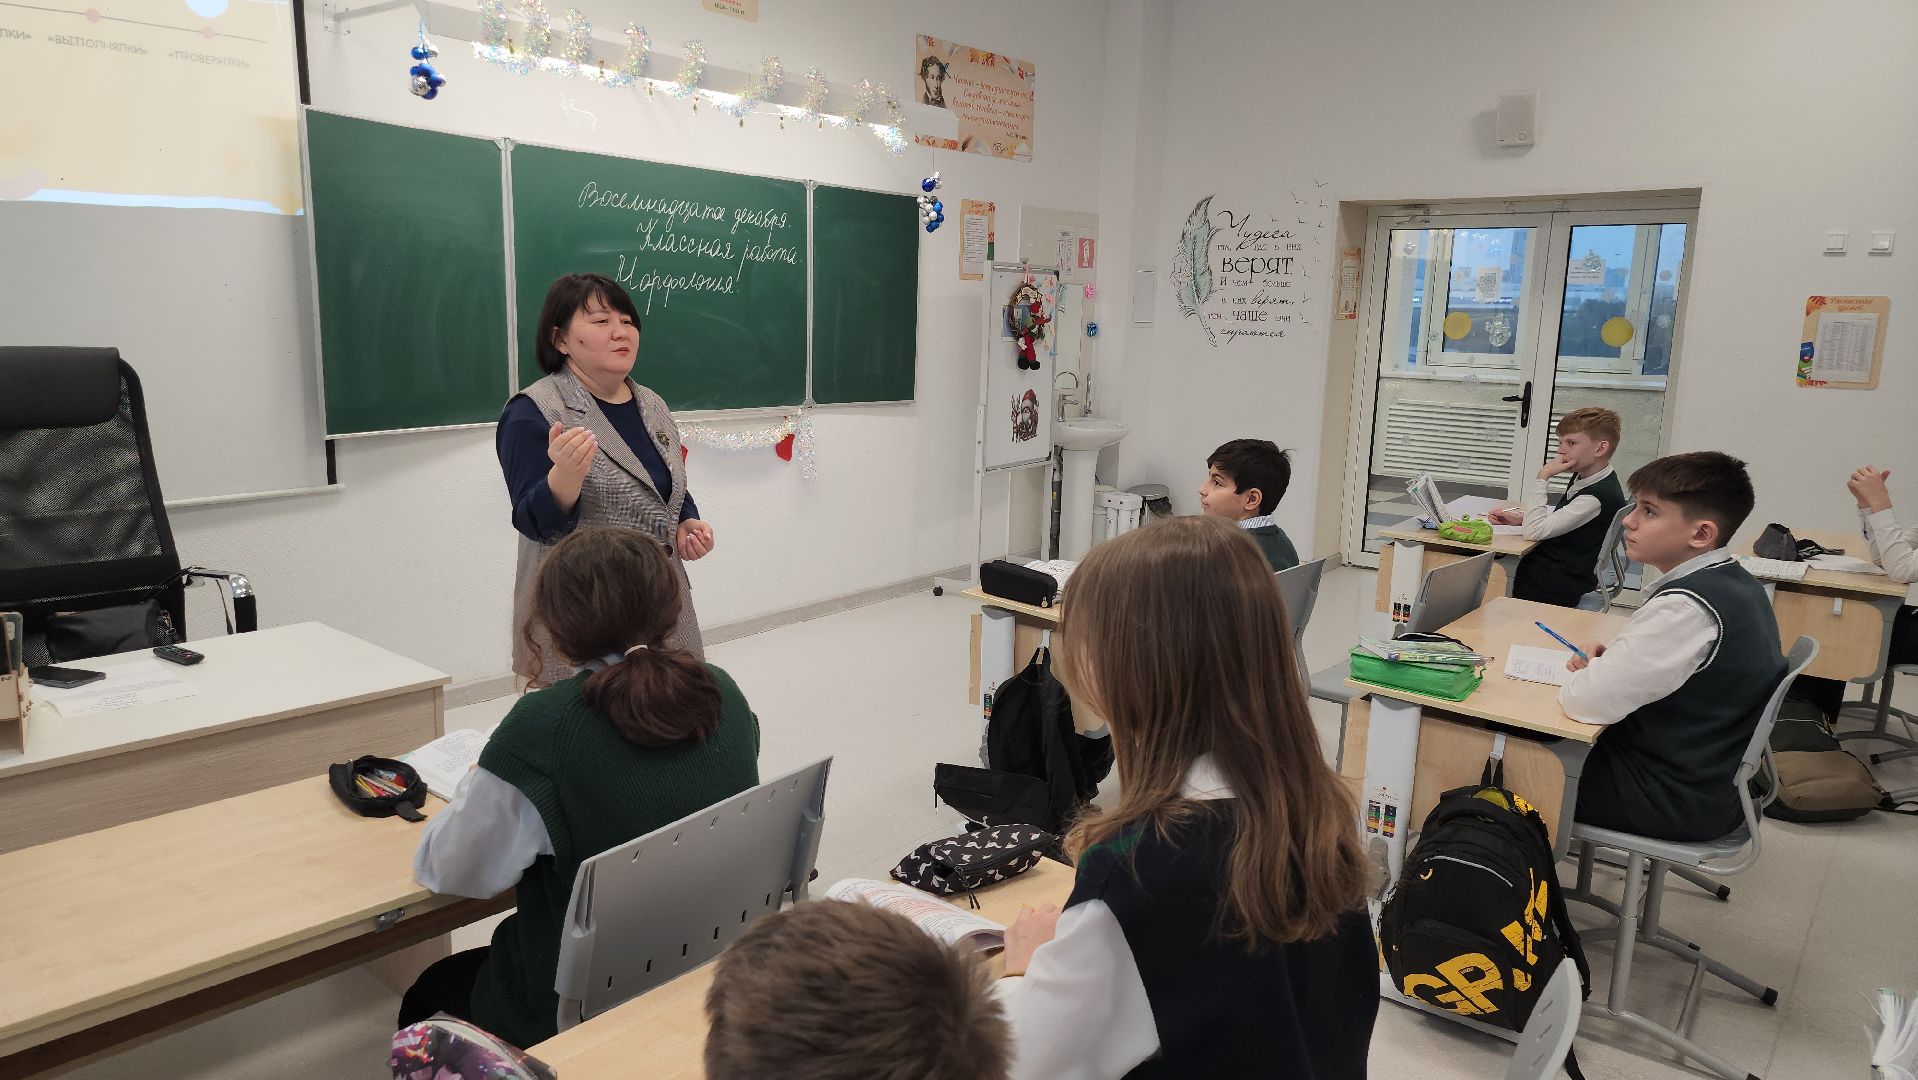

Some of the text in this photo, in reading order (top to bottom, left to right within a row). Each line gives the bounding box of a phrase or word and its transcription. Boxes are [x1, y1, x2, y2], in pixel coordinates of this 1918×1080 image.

[637, 218, 735, 260] Классная
[1217, 211, 1296, 251] Чудеса
[1222, 257, 1294, 284] верят.
